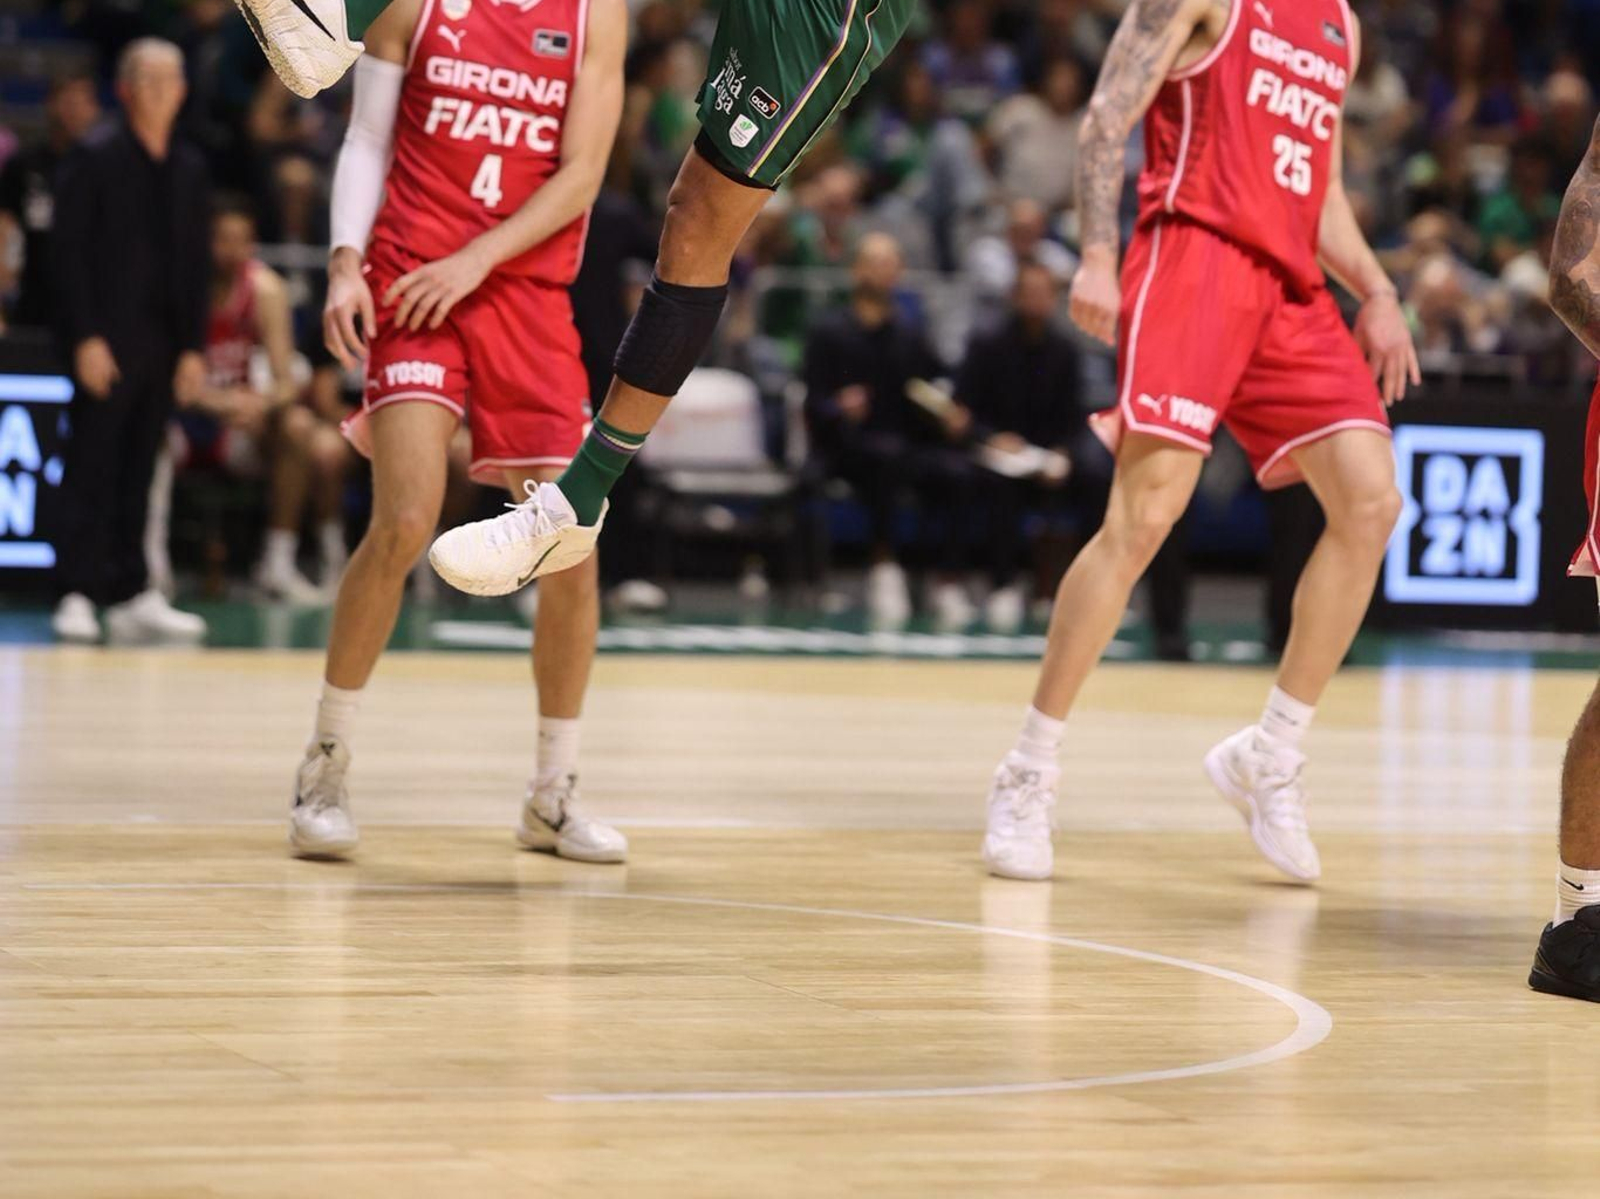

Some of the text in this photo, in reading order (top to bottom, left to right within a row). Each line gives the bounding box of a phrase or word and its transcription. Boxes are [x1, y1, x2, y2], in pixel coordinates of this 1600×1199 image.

[426, 55, 568, 108] GIRONA
[751, 95, 770, 113] acb
[1246, 68, 1340, 141] FIATC
[424, 96, 560, 152] FIATC
[470, 154, 503, 208] 4
[1272, 134, 1313, 196] 25
[385, 360, 446, 389] YOSOY
